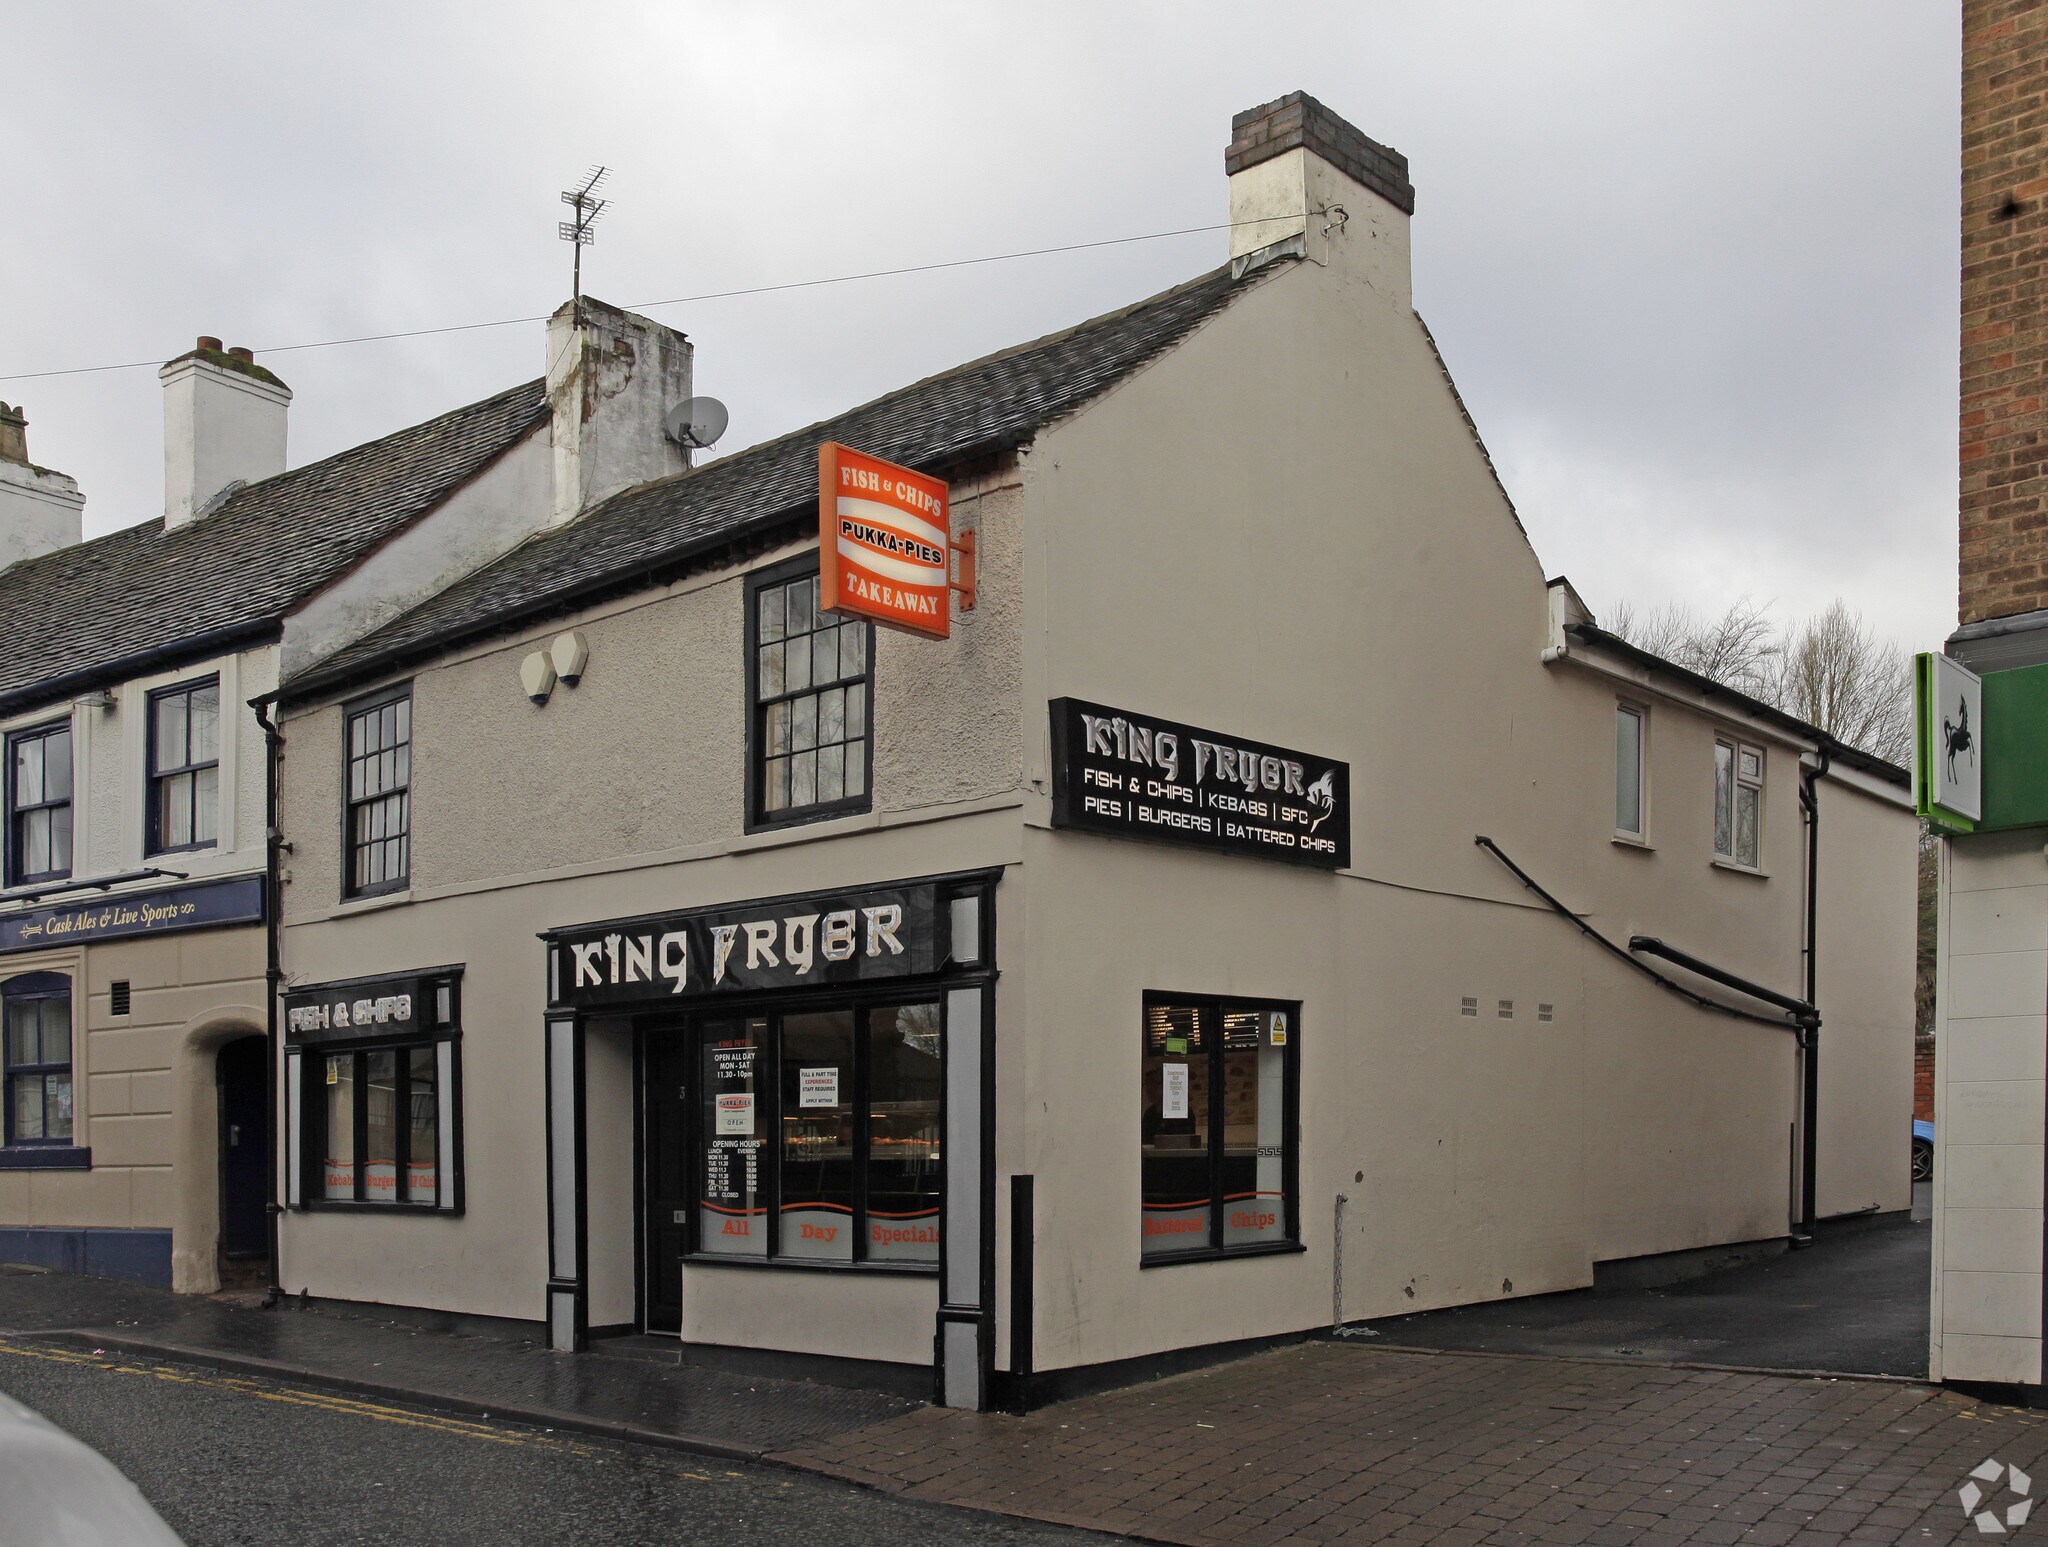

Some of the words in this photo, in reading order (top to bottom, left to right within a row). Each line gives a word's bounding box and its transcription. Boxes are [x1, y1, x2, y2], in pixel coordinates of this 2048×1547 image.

[841, 466, 880, 492] FISH
[883, 480, 892, 492] &
[896, 482, 942, 516] CHIPS
[842, 521, 942, 564] PUKKA-PIES
[847, 572, 938, 614] TAKEAWAY
[1080, 714, 1178, 782] KING
[1191, 738, 1304, 796] FRYER
[1084, 768, 1122, 790] FISH
[1130, 778, 1140, 793] &
[1147, 780, 1193, 804] CHIPS
[1208, 793, 1268, 817] KEBABS
[1282, 806, 1308, 824] SFC
[1085, 796, 1122, 817] PIES
[1138, 806, 1212, 832] BURGERS
[1226, 823, 1294, 846] BATTERED
[1300, 836, 1336, 853] CHIPS
[46, 914, 71, 934] Cask
[73, 911, 96, 931] Ales
[100, 908, 112, 928] &
[113, 907, 138, 926] Live
[140, 903, 178, 927] Sports
[570, 931, 687, 994] KING
[710, 904, 905, 986] FRYER
[289, 1004, 329, 1032] FISH
[333, 1002, 350, 1028] &
[353, 994, 411, 1025] CHIPS
[680, 1086, 685, 1099] 3
[737, 1071, 752, 1079] 10pm
[722, 1220, 749, 1236] All
[800, 1224, 838, 1242] Day
[1144, 1215, 1203, 1236] Battered
[1232, 1212, 1275, 1229] Chips
